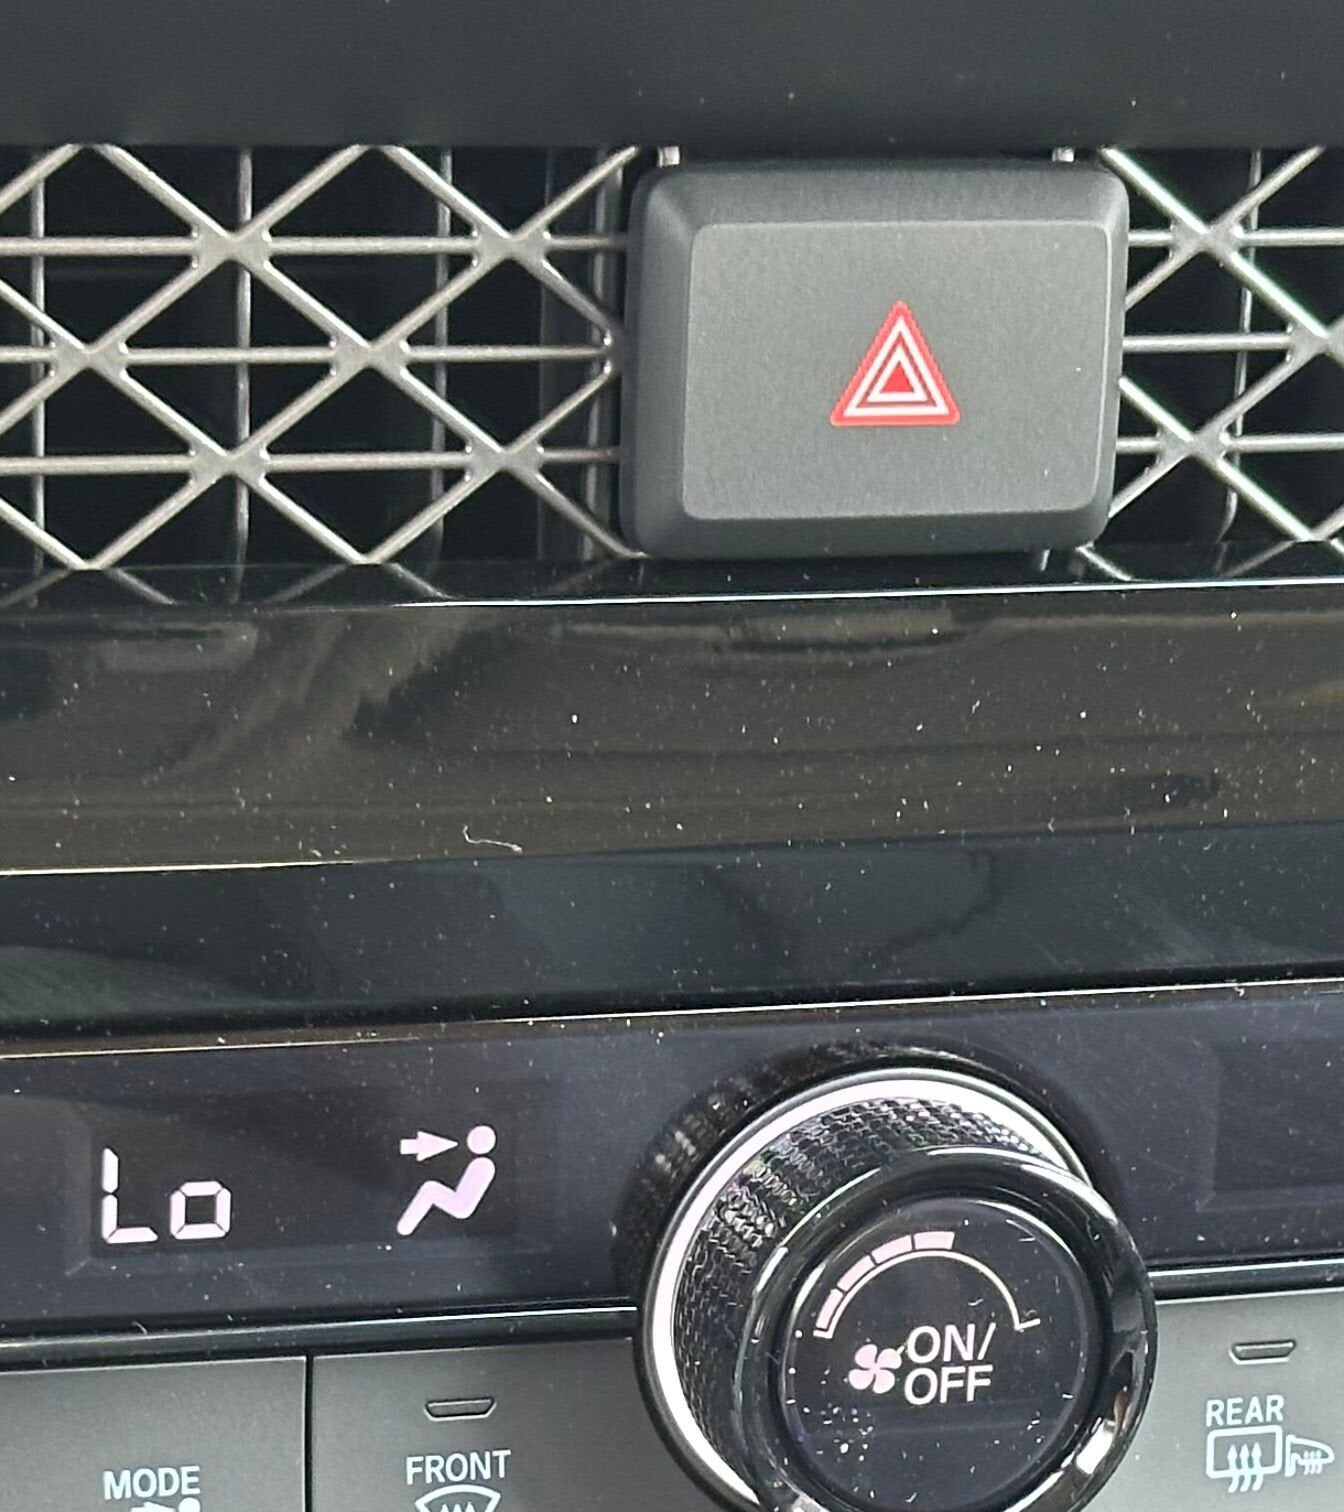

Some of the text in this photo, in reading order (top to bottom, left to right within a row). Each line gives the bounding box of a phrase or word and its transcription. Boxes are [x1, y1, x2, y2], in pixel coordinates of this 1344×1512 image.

[100, 1147, 233, 1245] Lo
[906, 1321, 997, 1366] ON/
[903, 1362, 994, 1406] OFF
[1205, 1394, 1285, 1426] REAR
[102, 1465, 202, 1500] MODE
[404, 1449, 512, 1486] FRONT
